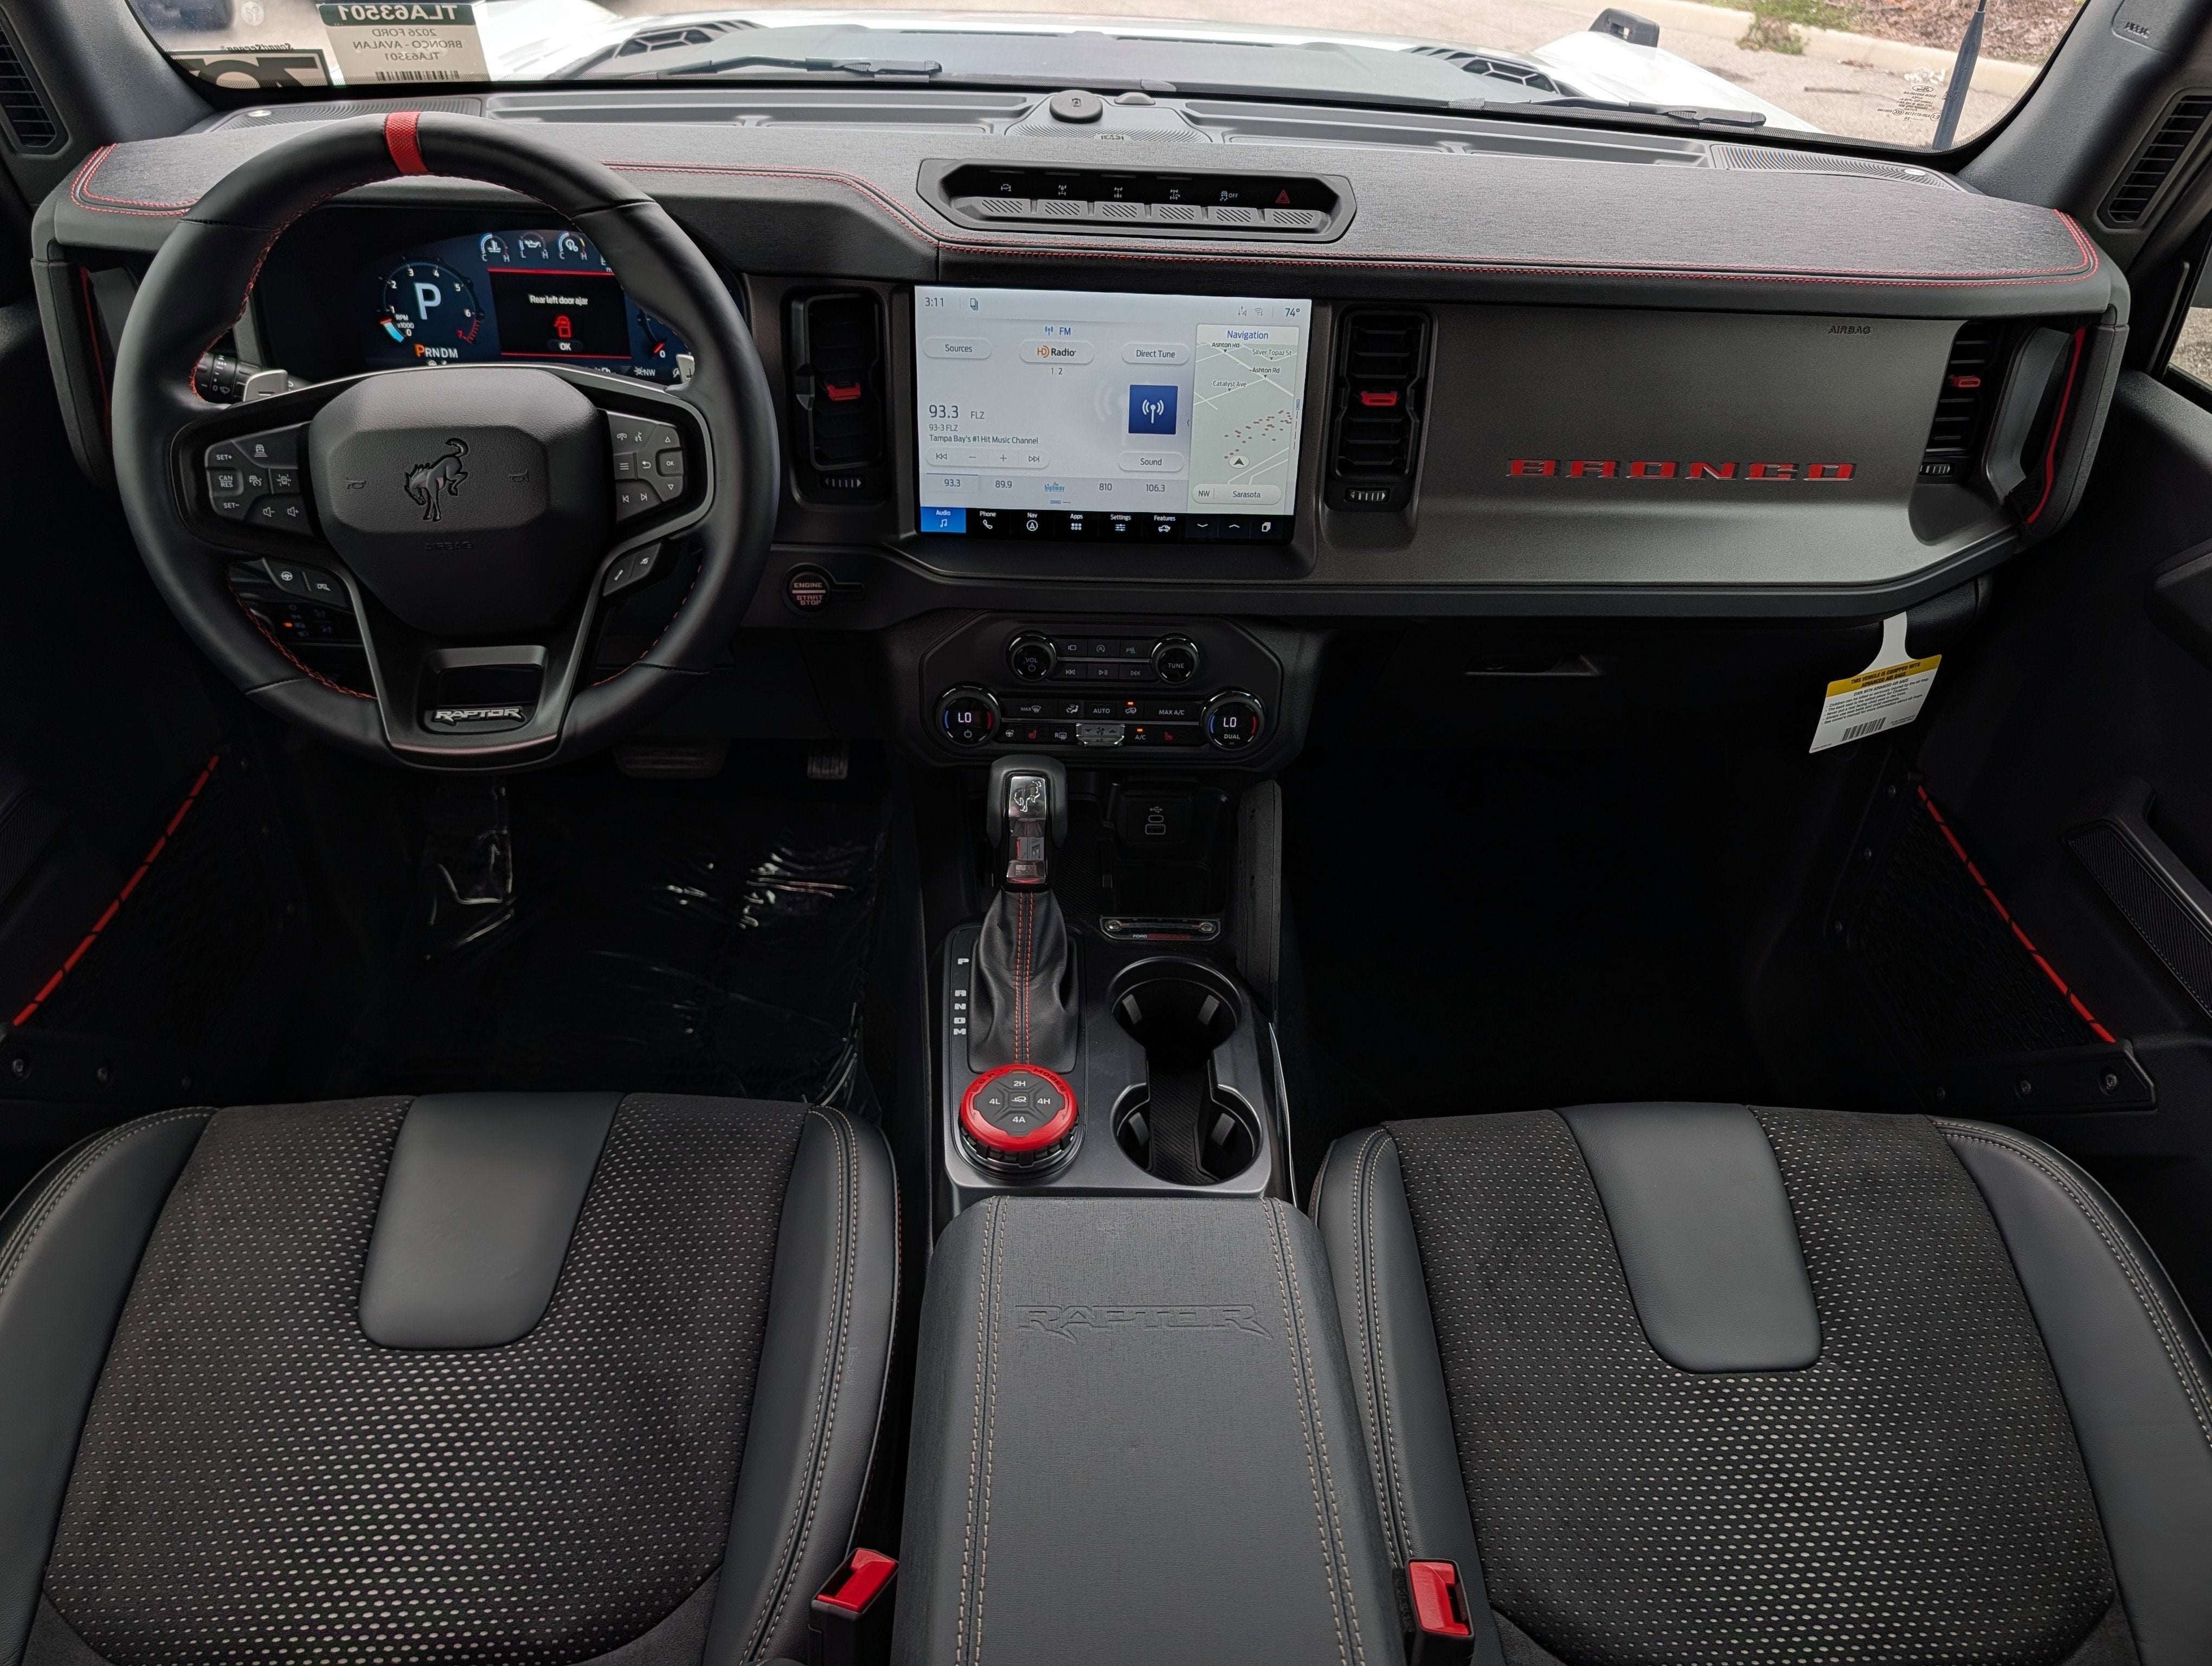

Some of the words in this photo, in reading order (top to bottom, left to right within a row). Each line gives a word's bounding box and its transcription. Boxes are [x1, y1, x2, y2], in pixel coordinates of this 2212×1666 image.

[391, 281, 397, 289] 2
[455, 283, 461, 292] 5
[414, 283, 441, 321] P
[529, 294, 544, 304] Rear
[545, 295, 558, 305] left
[559, 296, 575, 305] door
[576, 297, 588, 306] ajar
[925, 297, 944, 307] 3:11
[465, 309, 471, 317] 6
[1285, 307, 1300, 317] 74°
[1059, 327, 1071, 336] FM
[1227, 330, 1269, 340] Navigation
[1828, 325, 1871, 335] AIRBAG
[559, 343, 571, 351] OK
[945, 344, 973, 353] Sources
[1136, 350, 1156, 358] Direct
[1158, 350, 1175, 358] Tune
[1213, 380, 1234, 388] Catalyst
[929, 405, 959, 419] 93.3
[971, 411, 985, 419] FLZ
[929, 434, 952, 443] Tampa
[954, 435, 971, 444] Bay's
[1012, 437, 1038, 445] Channel
[1140, 458, 1162, 466] Sound
[1506, 458, 1856, 480] BRONCO
[944, 479, 961, 487] 93.3
[995, 480, 1012, 488] 89.9
[1862, 672, 1880, 681] VEHICLE
[1887, 665, 1908, 675] EQUIPPED
[1861, 677, 1885, 687] ADVANCED
[434, 708, 522, 722] RAPTOR
[957, 712, 972, 723] LO
[1223, 717, 1237, 728] LO
[1033, 1068, 1067, 1092] MODES
[1015, 1305, 1276, 1344] RAPTOR
